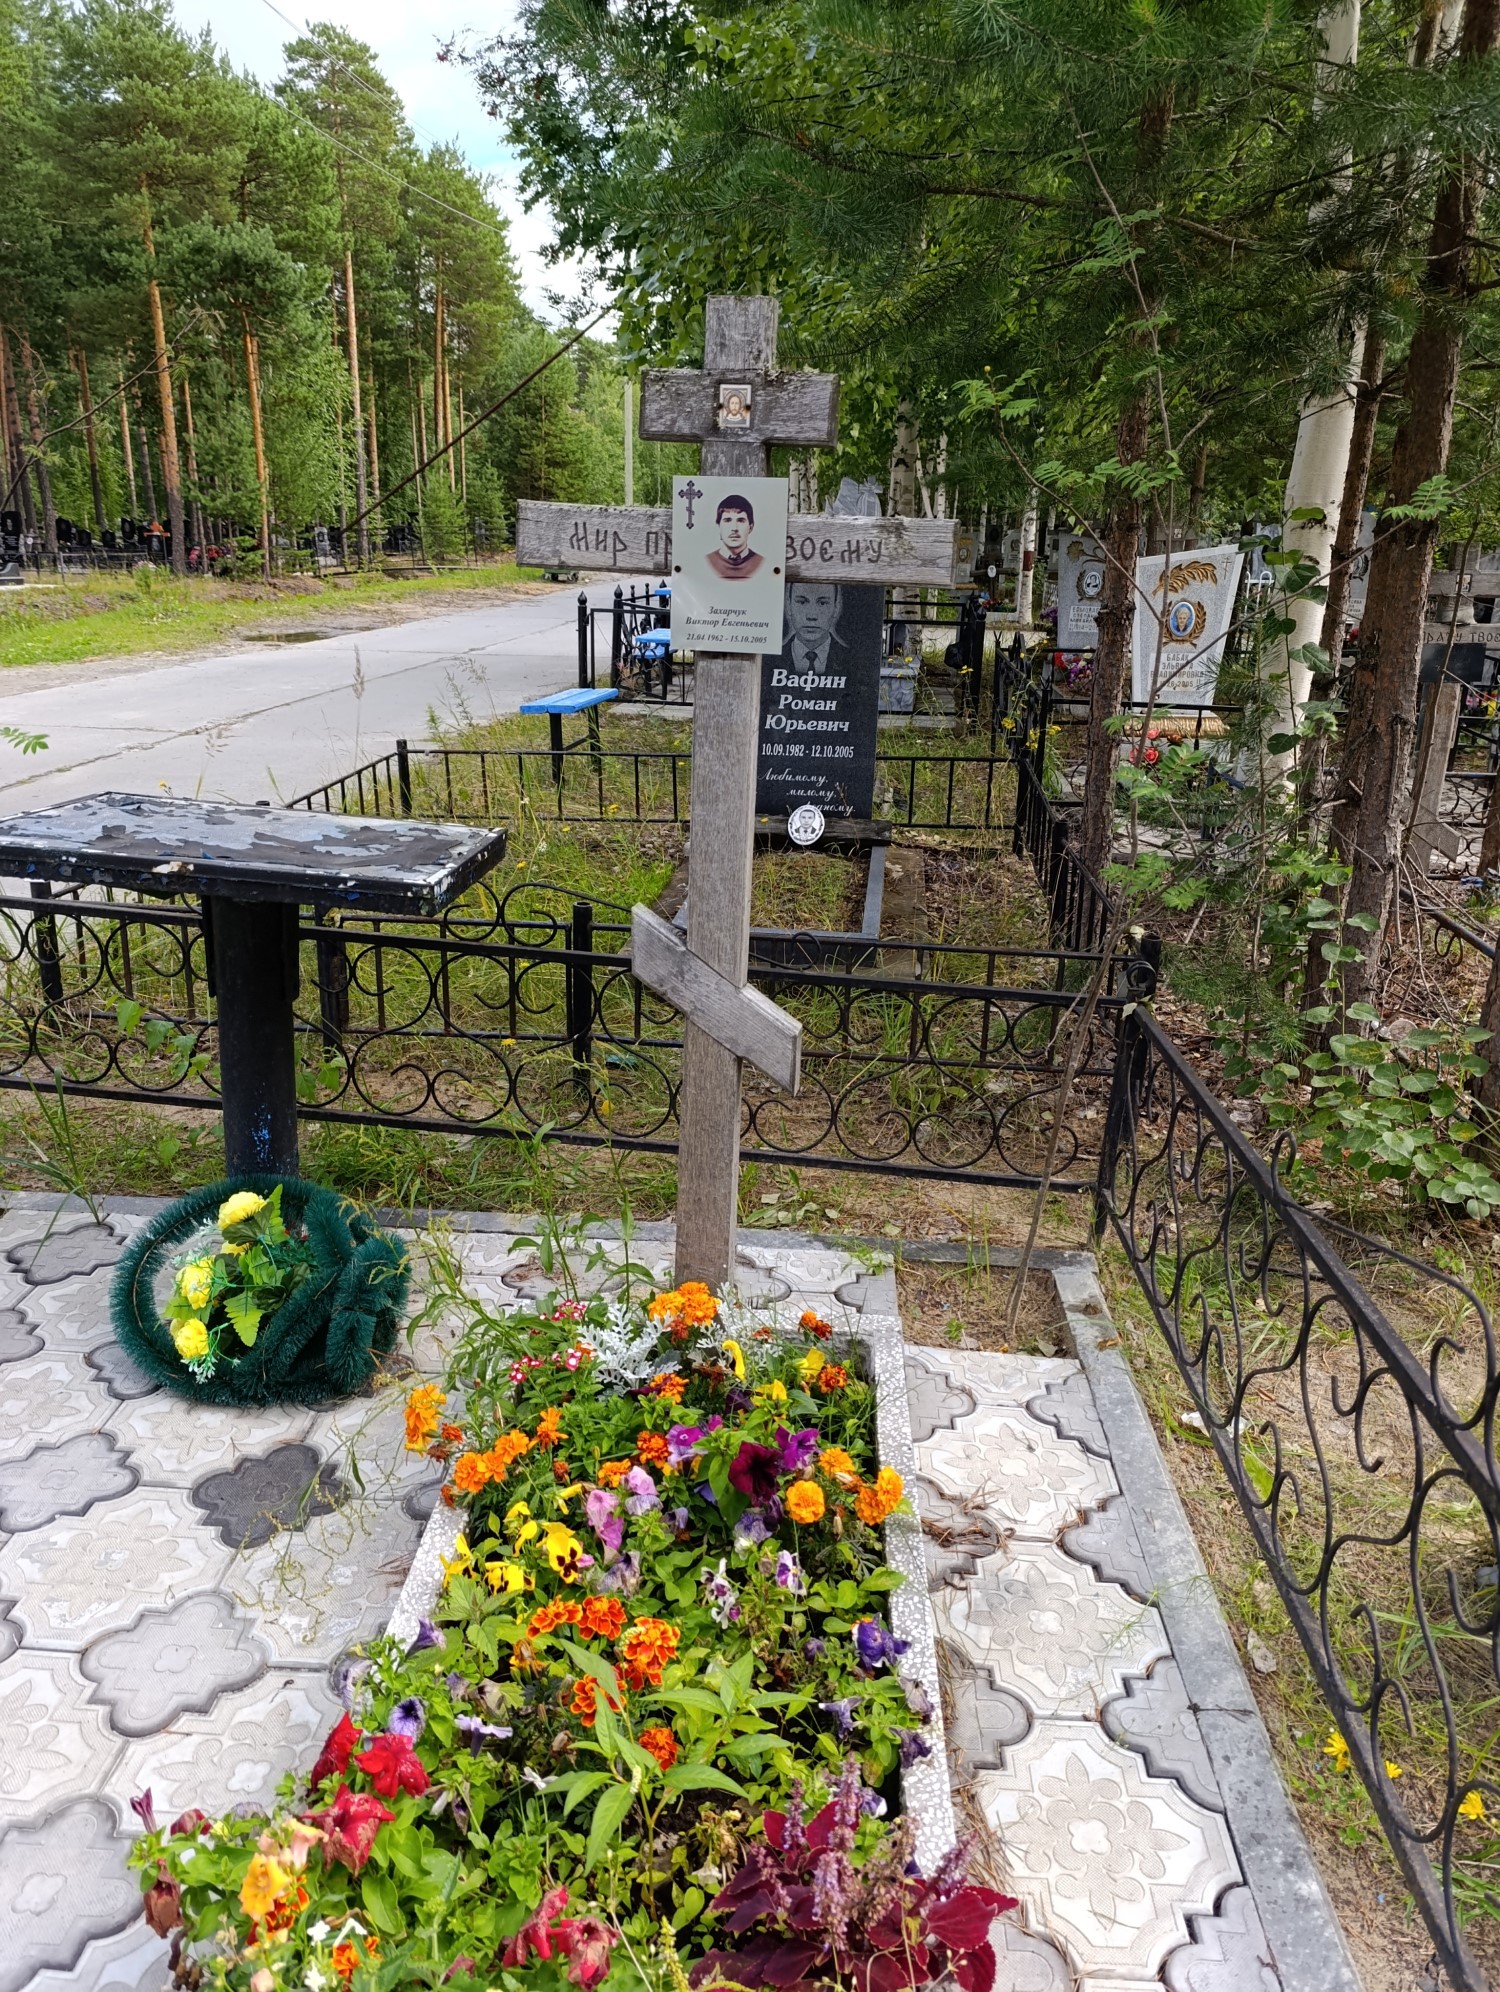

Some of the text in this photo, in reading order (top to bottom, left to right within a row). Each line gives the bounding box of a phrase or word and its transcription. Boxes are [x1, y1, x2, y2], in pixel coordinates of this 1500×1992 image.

[708, 606, 748, 618] Захарчук
[685, 616, 769, 628] Виктор Евгеньевич
[686, 633, 723, 642] 21.04.1962
[730, 635, 767, 644] 15.10.2005
[1162, 662, 1194, 670] ЭЛЬВИА
[770, 669, 847, 692] Вафин
[778, 694, 837, 711] Роман
[765, 714, 850, 733] Юрьевич
[761, 743, 805, 757] 10.09.1982
[811, 745, 855, 758] 12.10.2005
[786, 789, 837, 802] милому,
